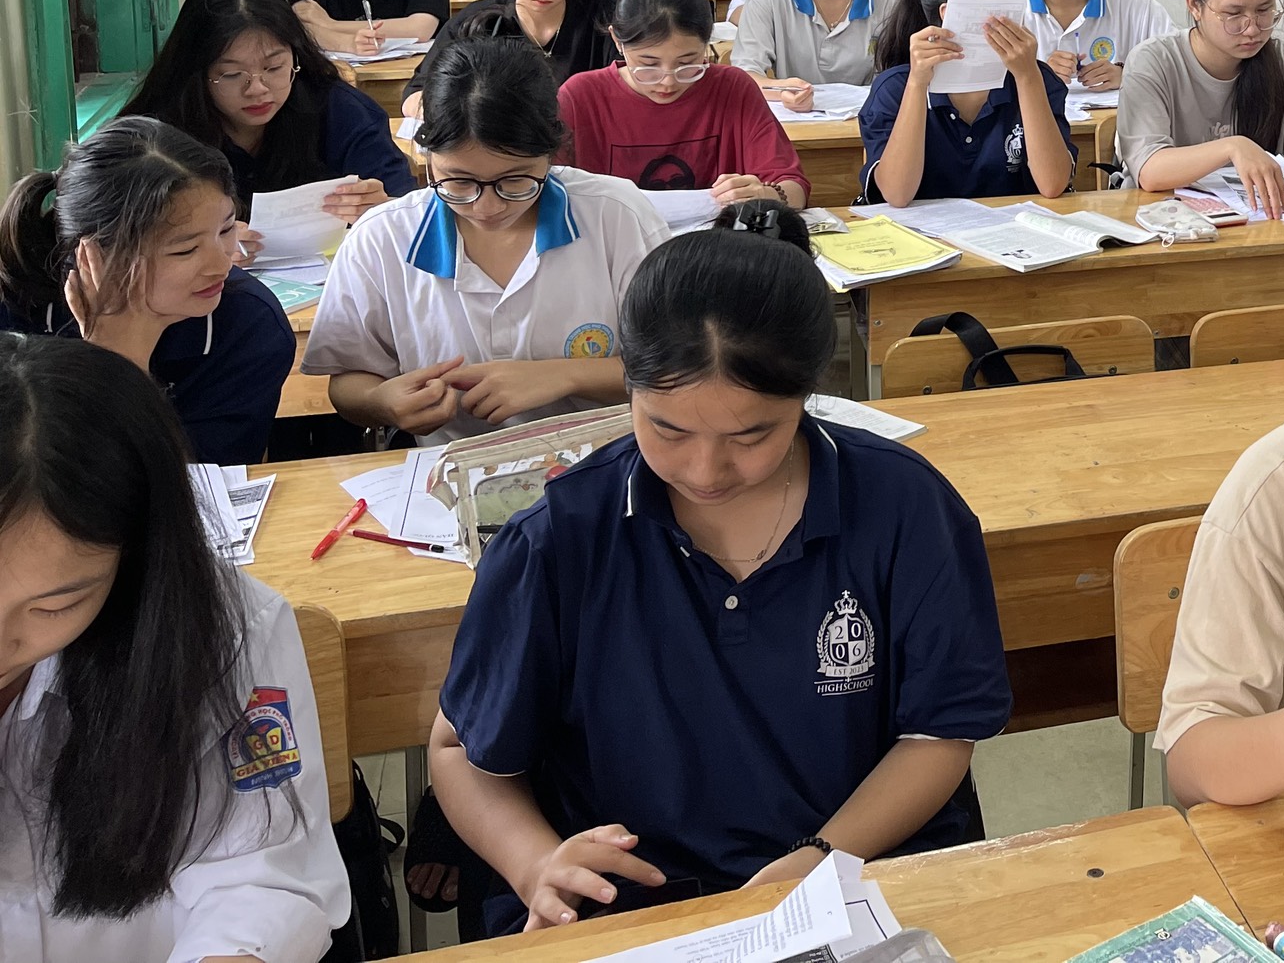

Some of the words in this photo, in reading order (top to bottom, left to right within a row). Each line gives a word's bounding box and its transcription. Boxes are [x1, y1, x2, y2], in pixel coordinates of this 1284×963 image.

[833, 667, 846, 676] EST
[269, 734, 280, 745] D
[236, 764, 260, 778] GIA
